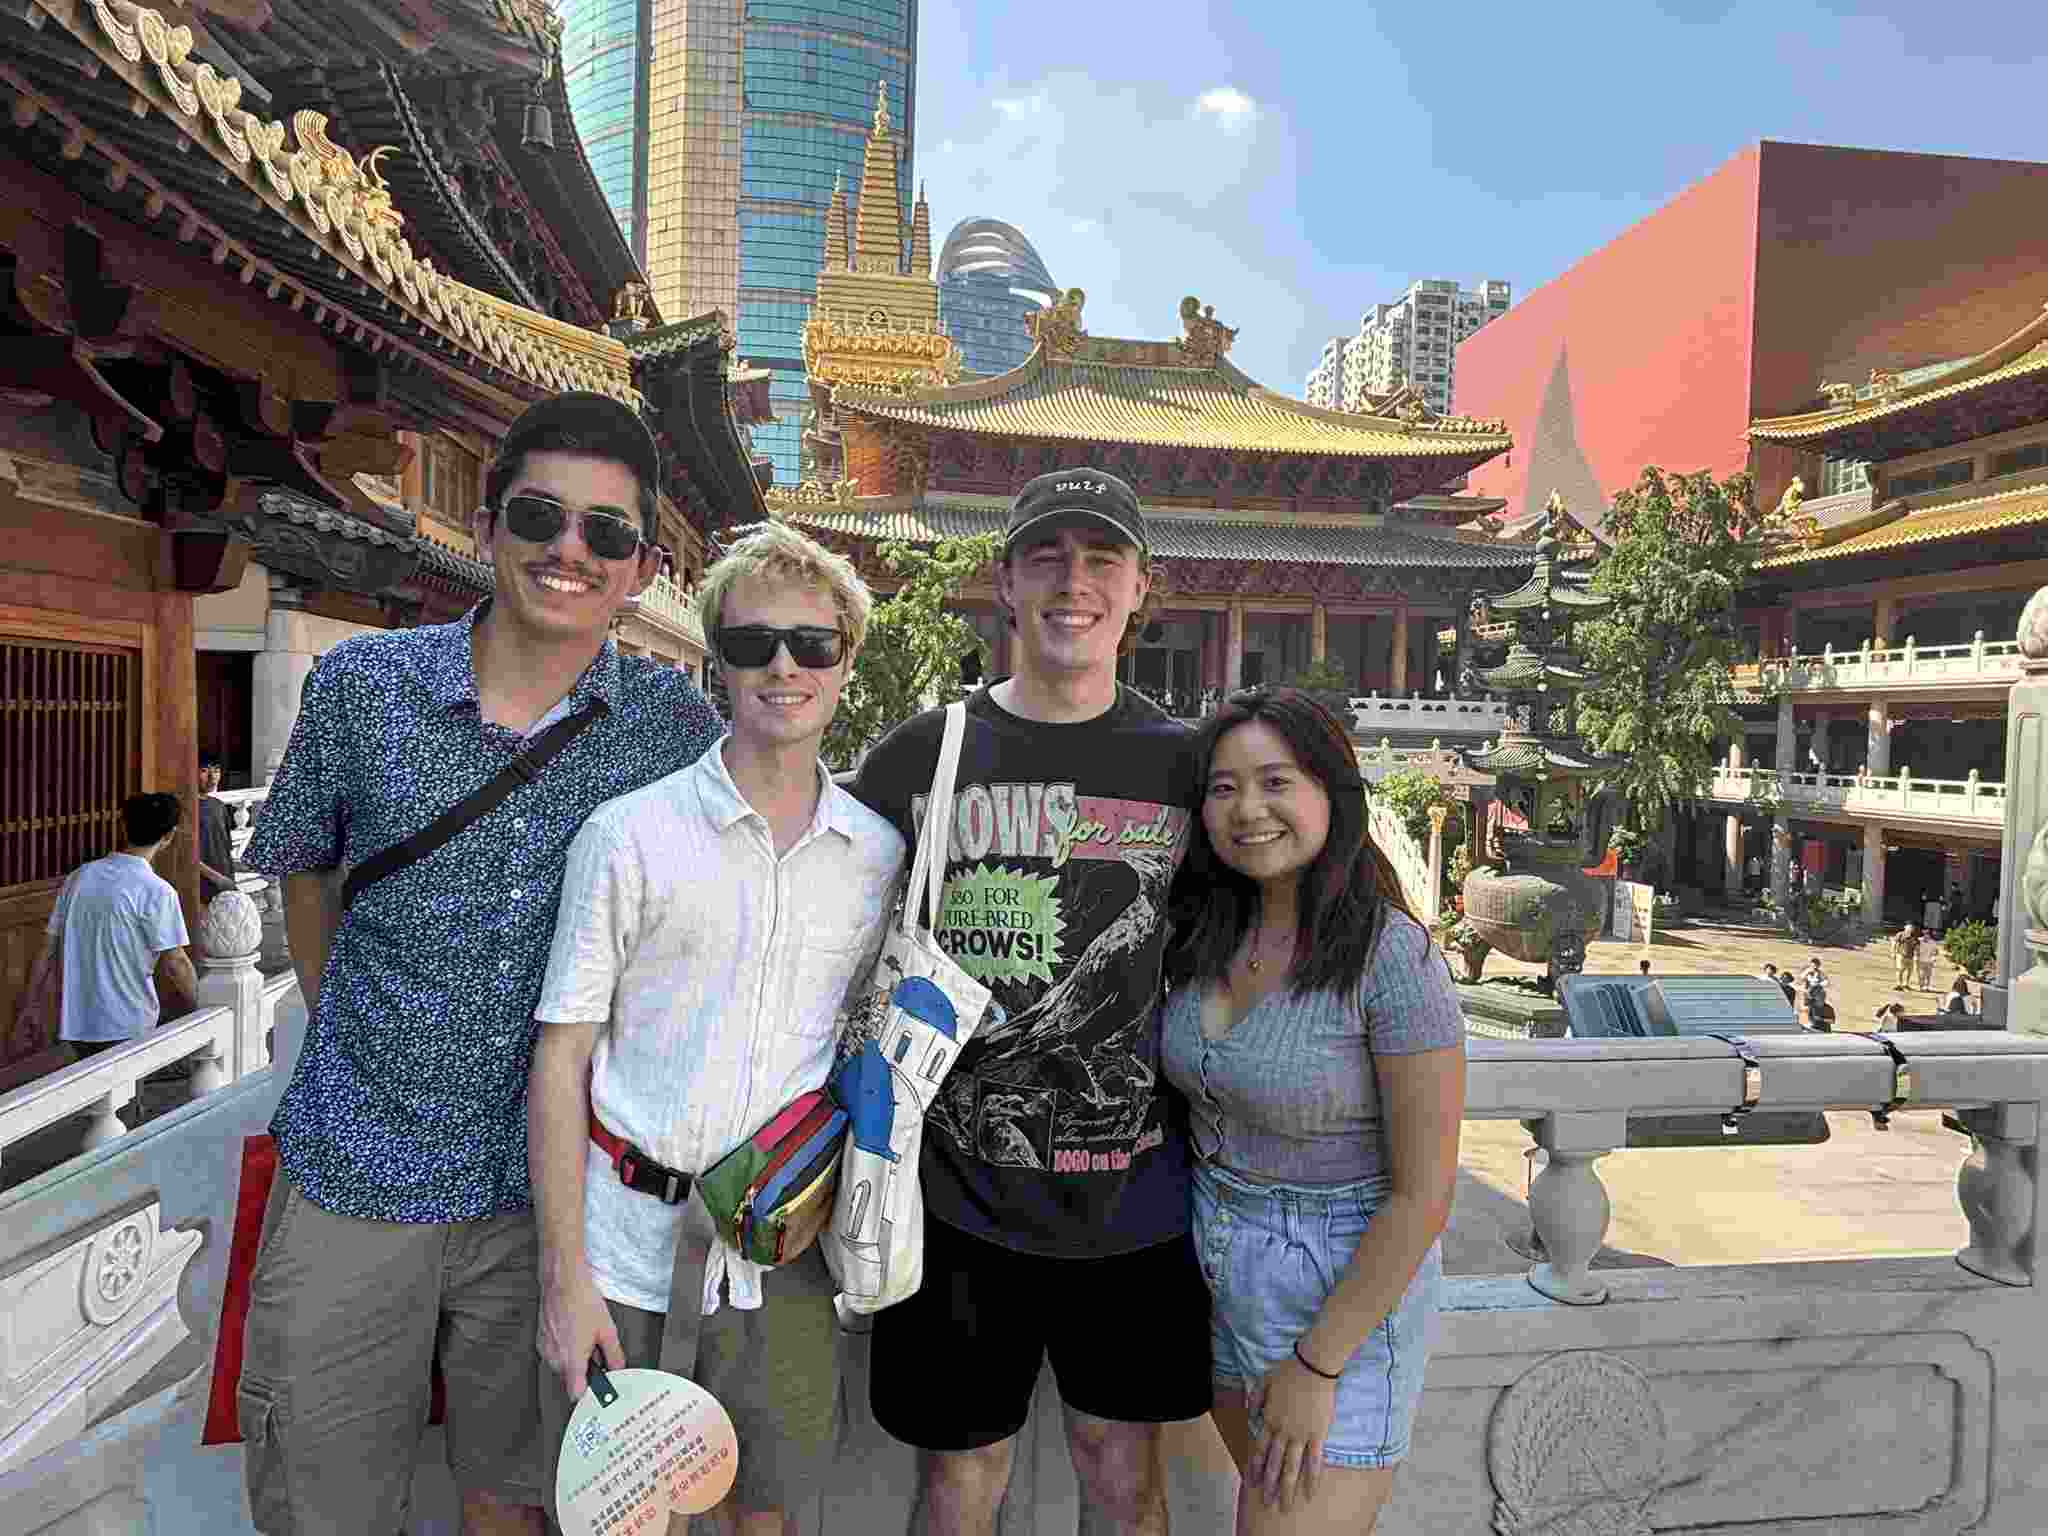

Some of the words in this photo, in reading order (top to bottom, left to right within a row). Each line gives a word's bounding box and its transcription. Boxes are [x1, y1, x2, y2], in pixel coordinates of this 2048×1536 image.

[912, 783, 1076, 861] OWS
[984, 887, 1020, 906] FOR
[943, 909, 1033, 930] URE-BRED
[938, 929, 1044, 963] CROWS!
